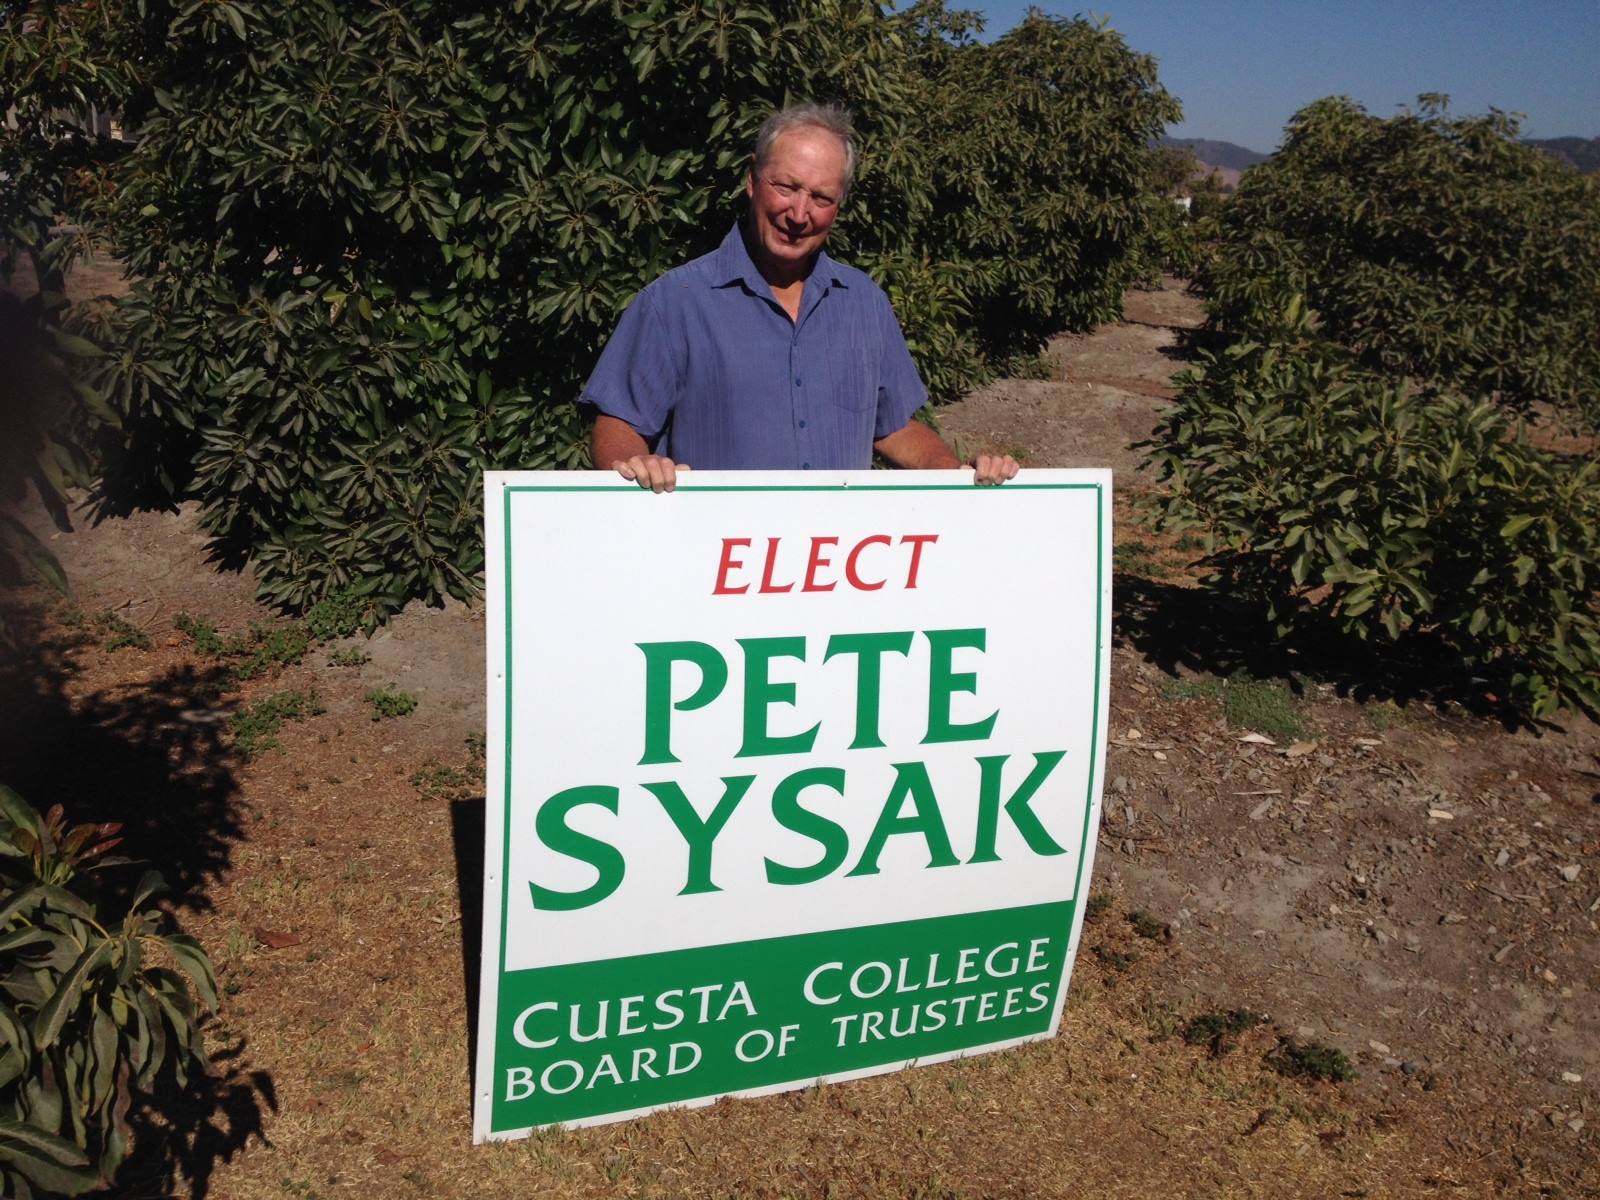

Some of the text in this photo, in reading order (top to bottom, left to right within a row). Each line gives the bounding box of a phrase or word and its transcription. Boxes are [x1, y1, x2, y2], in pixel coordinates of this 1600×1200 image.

[712, 535, 939, 595] ELECT
[634, 627, 1000, 764] PETE
[528, 750, 1068, 912] SYSAK
[505, 982, 1050, 1102] BOARD OF TRUSTEES
[512, 937, 1050, 1049] CUESTA COLLEGE
